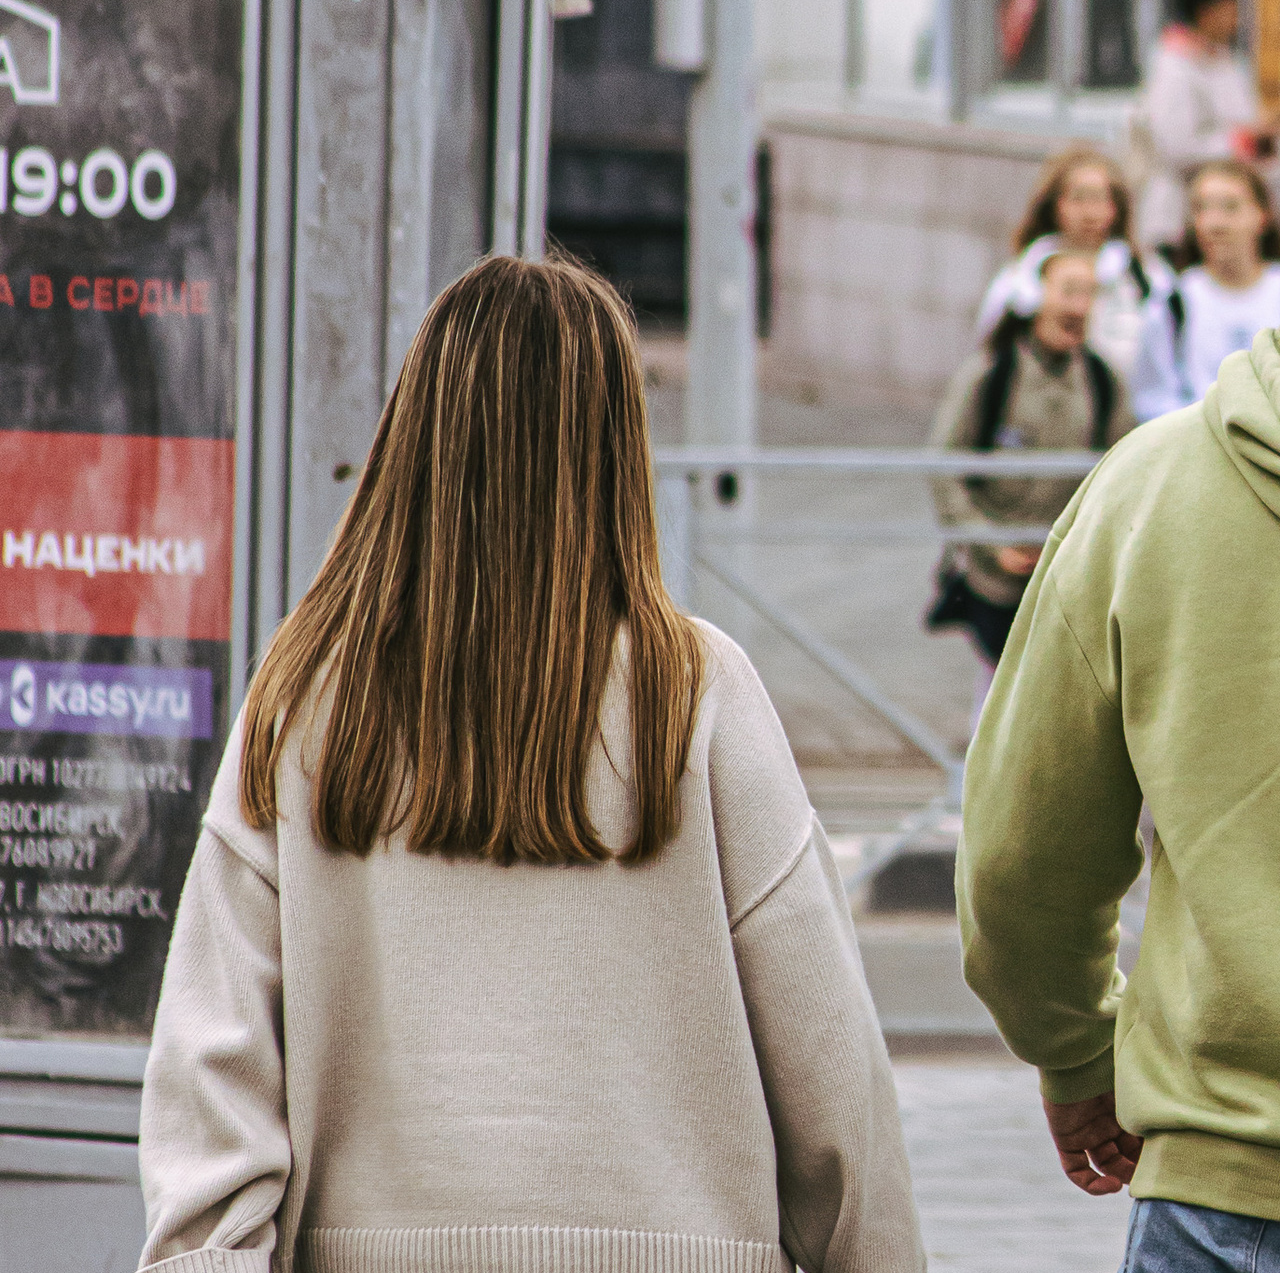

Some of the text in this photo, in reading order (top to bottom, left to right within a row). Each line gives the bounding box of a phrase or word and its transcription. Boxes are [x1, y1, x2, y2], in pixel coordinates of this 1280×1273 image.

[29, 275, 54, 309] В
[67, 277, 210, 317] СЕРДЦЕ
[3, 530, 204, 578] НАЦЕНКИ
